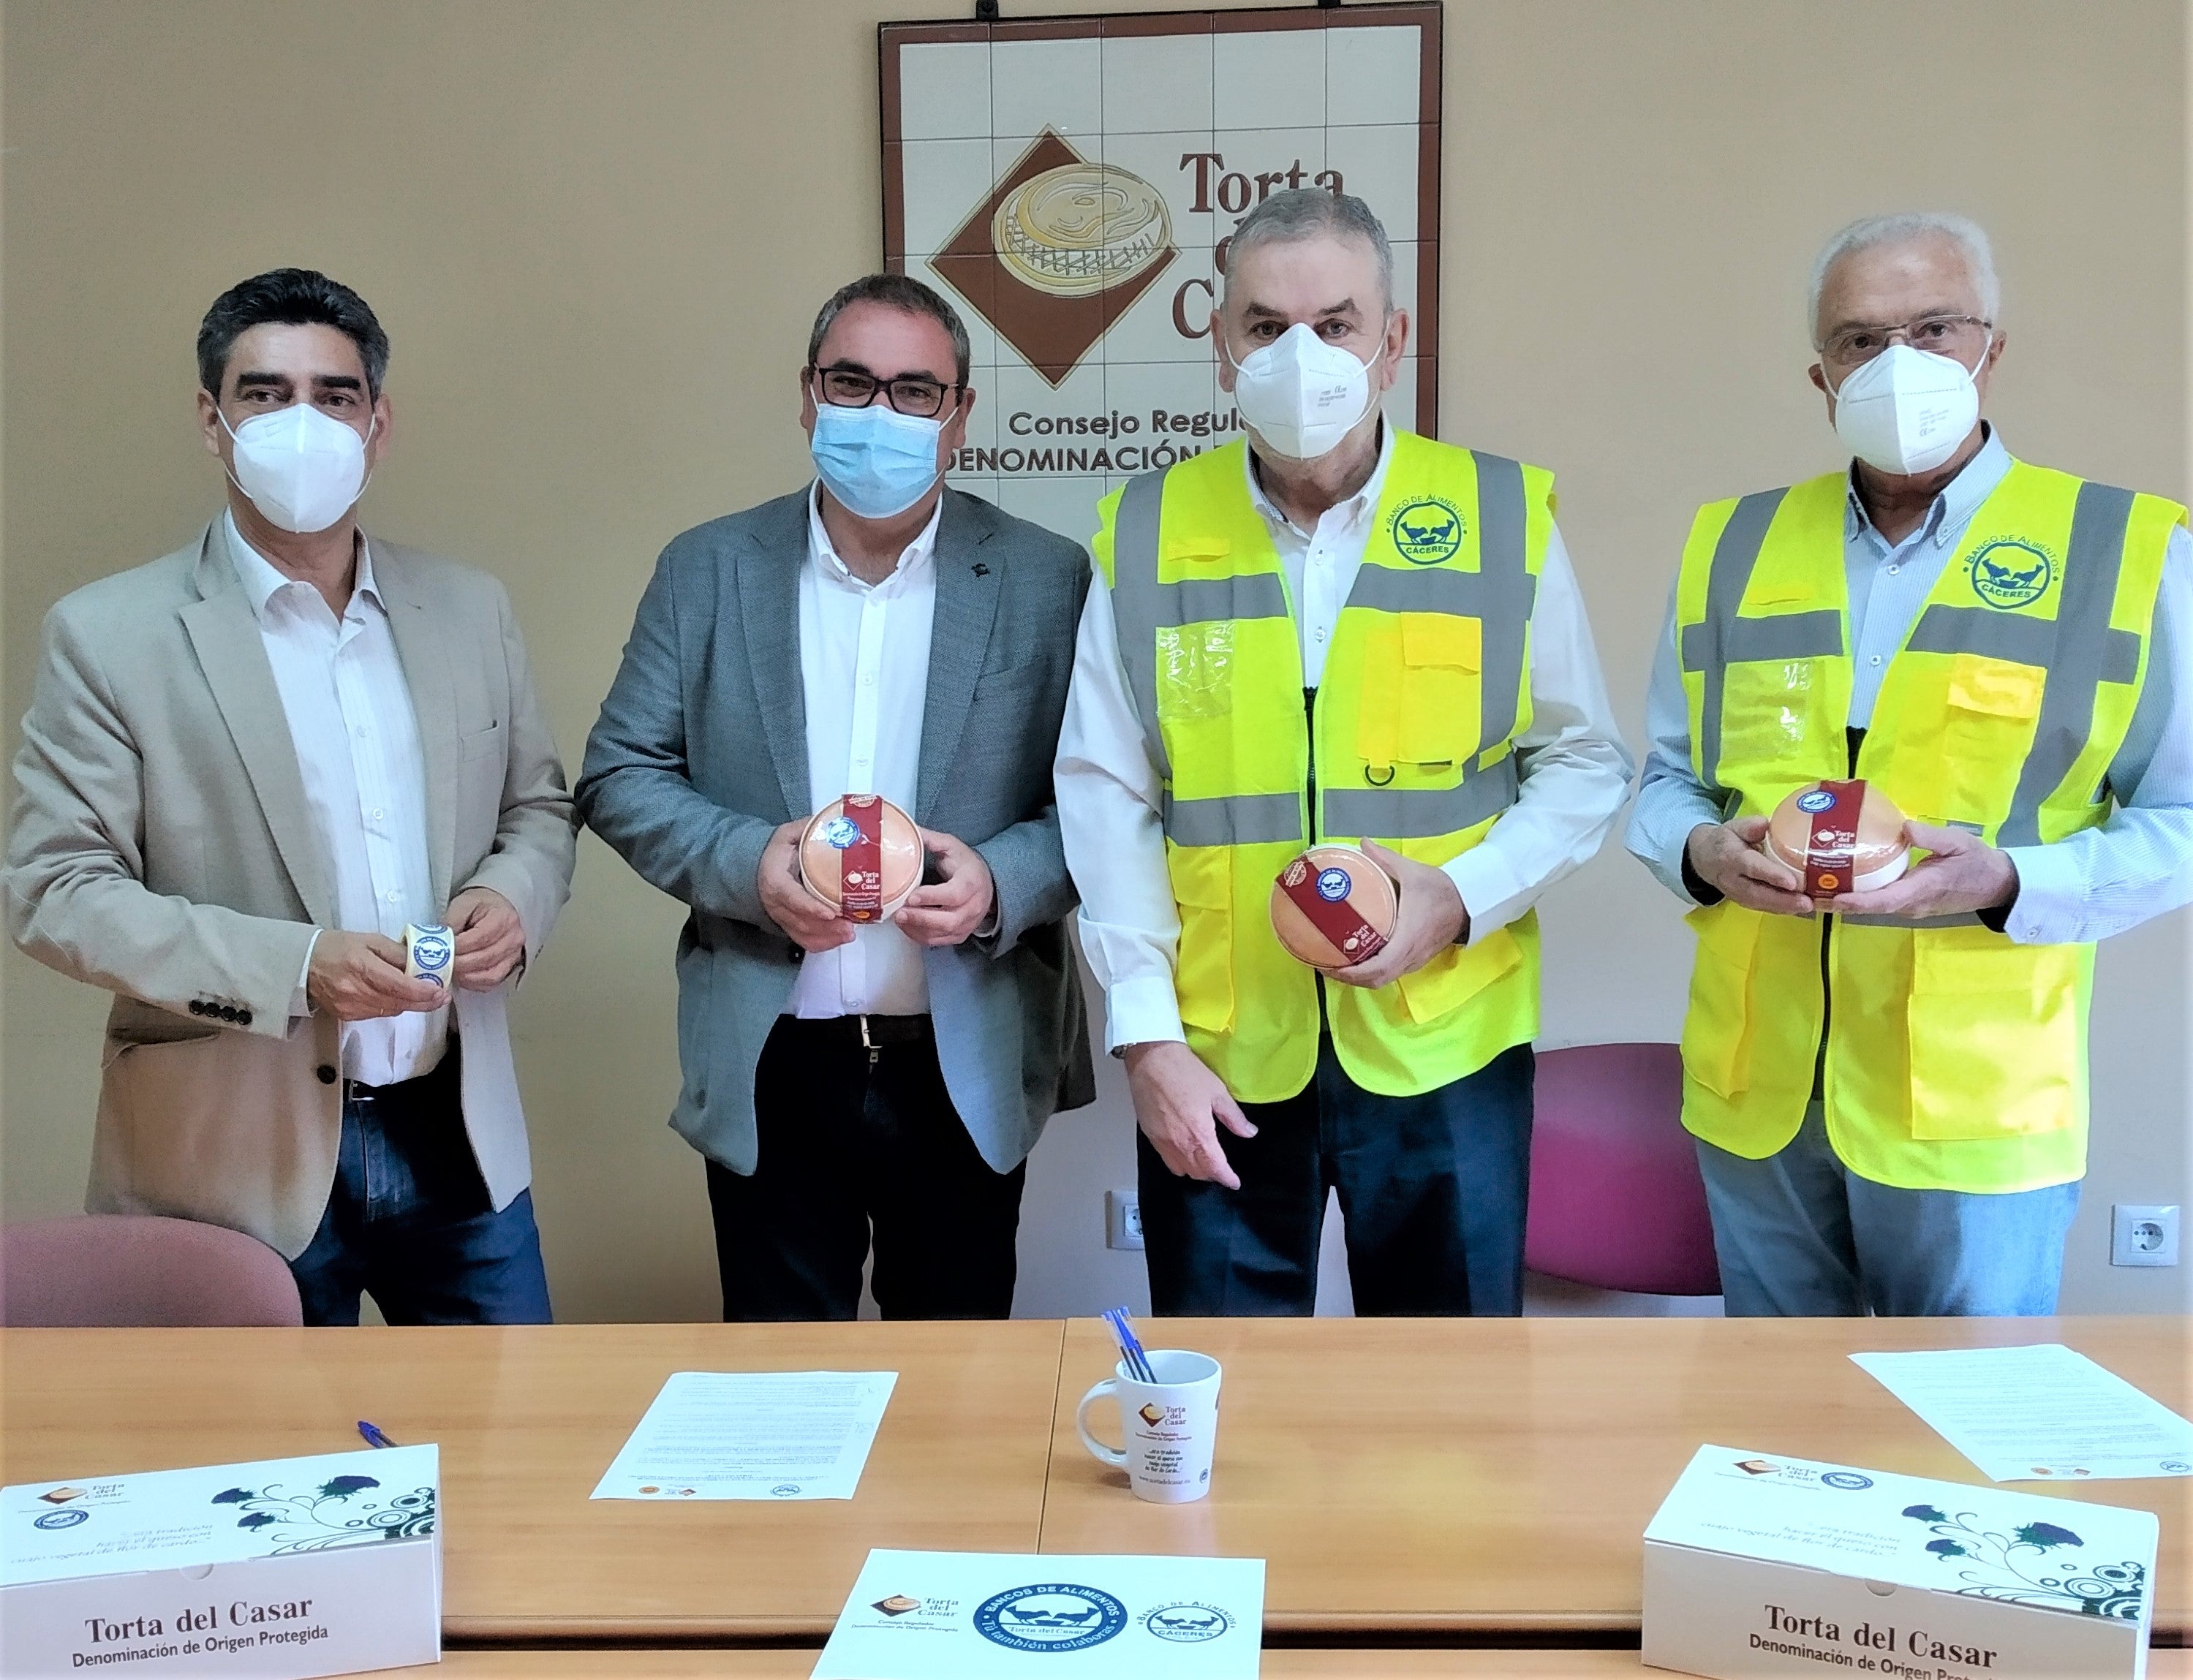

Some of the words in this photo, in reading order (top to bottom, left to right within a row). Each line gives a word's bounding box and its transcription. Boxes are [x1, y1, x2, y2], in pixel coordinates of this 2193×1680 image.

[1009, 410, 1140, 439] Consejo
[1386, 499, 1409, 526] BANCO
[1425, 493, 1468, 526] ALIMENTOS
[1964, 535, 1998, 564] BANCO
[2018, 536, 2060, 574] ALIMENTOS
[918, 1609, 959, 1617] Casar
[924, 1597, 959, 1605] Torta
[984, 1588, 1033, 1613] BANCOS
[1060, 1586, 1120, 1617] ALIMENTOS
[1136, 1605, 1165, 1621] BANCO
[84, 1616, 164, 1643] Torta
[176, 1605, 219, 1632] del
[229, 1599, 313, 1627] Casar
[982, 1619, 995, 1632] Tú
[992, 1629, 1046, 1650] también
[1052, 1625, 1116, 1650] colaboras
[1764, 1604, 1841, 1641] Torta
[1853, 1622, 1896, 1651] del
[1909, 1630, 1998, 1668] Casar
[72, 1642, 178, 1668] Denominación
[182, 1640, 201, 1654] de
[205, 1634, 254, 1654] Origen
[259, 1624, 329, 1646] Protegida
[1749, 1632, 1853, 1668] Denominación
[1857, 1654, 1876, 1671] de
[1880, 1658, 1932, 1680] Origen
